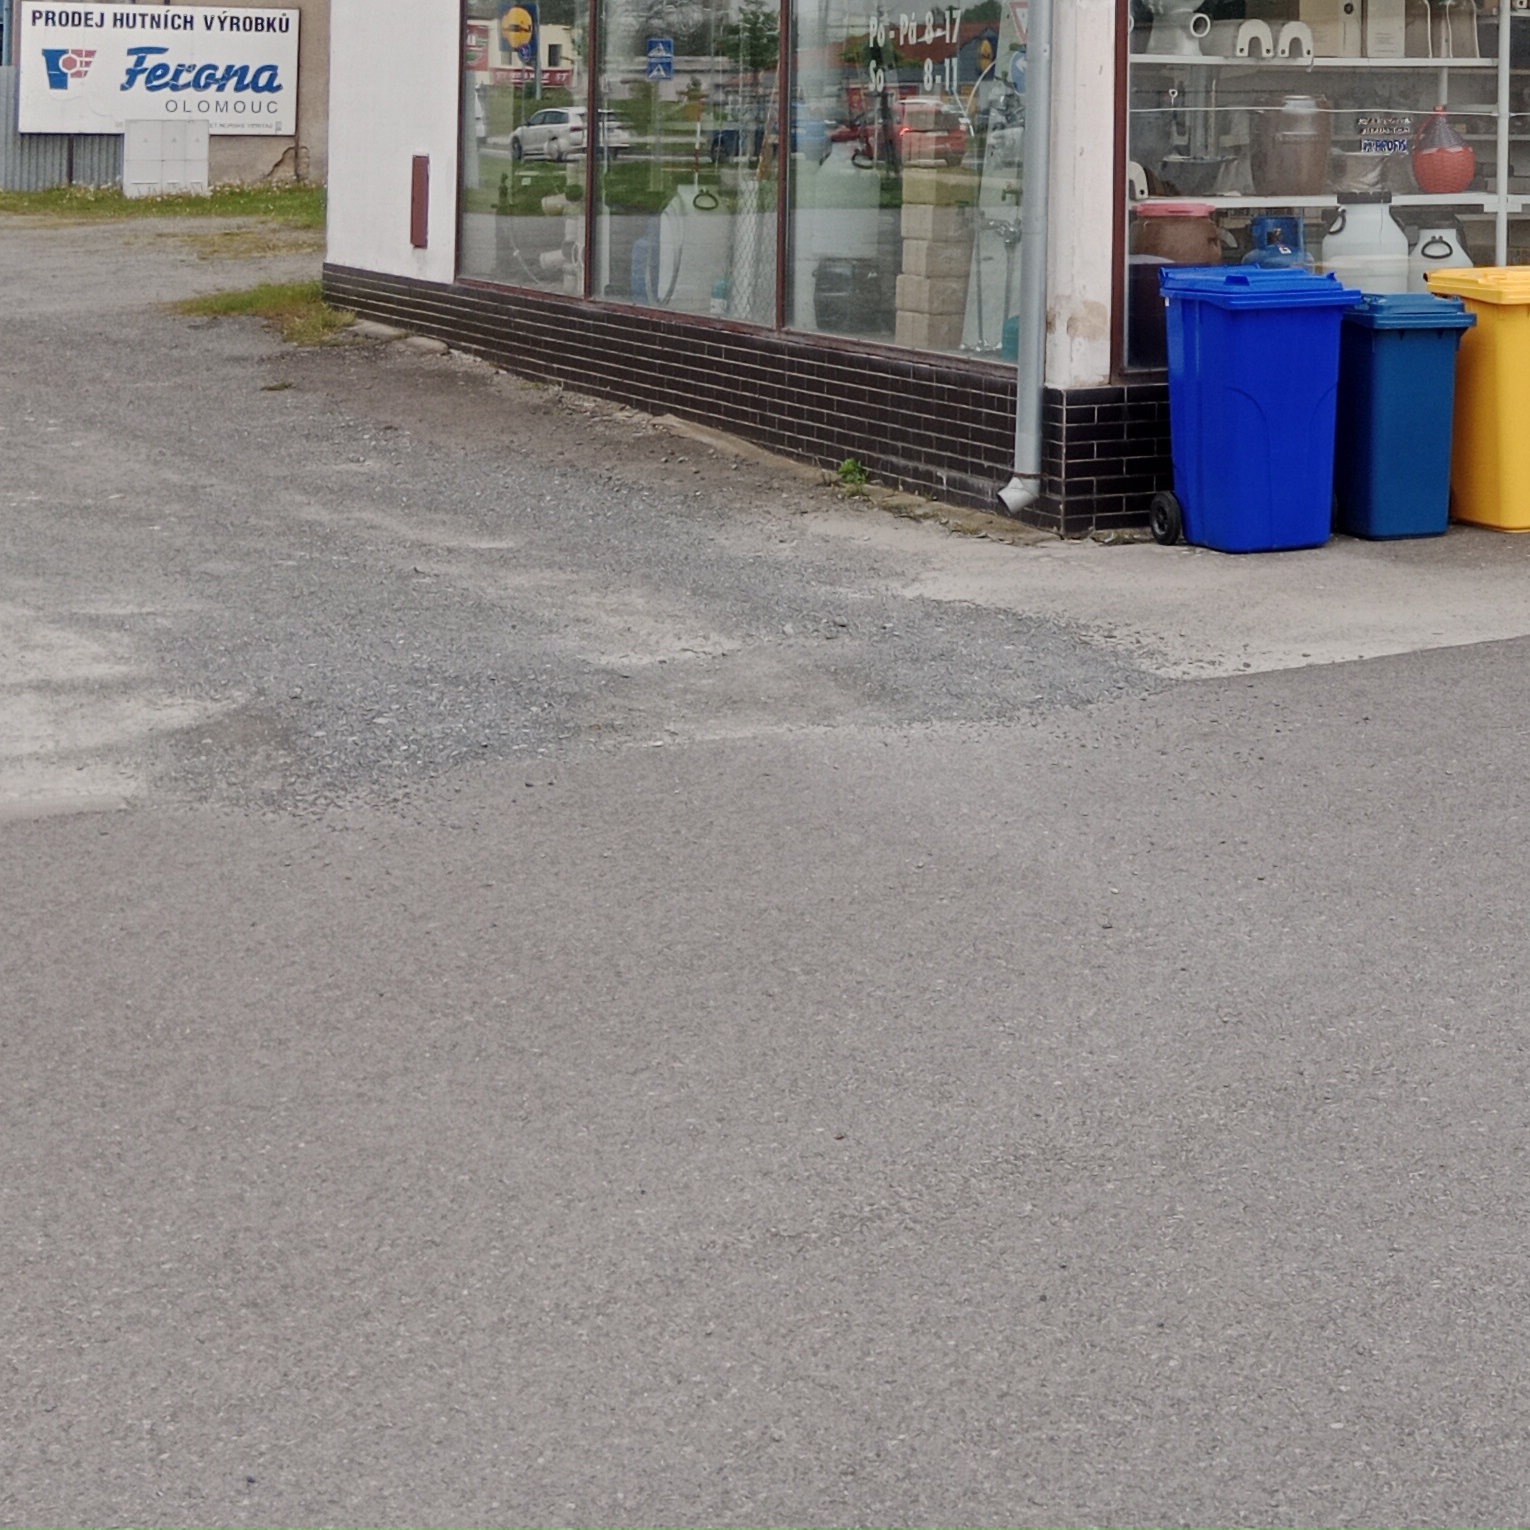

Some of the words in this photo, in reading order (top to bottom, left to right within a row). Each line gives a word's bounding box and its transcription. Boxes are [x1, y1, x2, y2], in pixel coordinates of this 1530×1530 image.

[31, 9, 105, 28] PRODEJ
[112, 9, 194, 31] HUTNÍCH
[203, 10, 290, 33] VÝROBKŮ
[899, 12, 917, 46] Pá
[120, 46, 284, 93] Ferona
[869, 60, 884, 93] So
[165, 99, 279, 114] OLOMOUC
